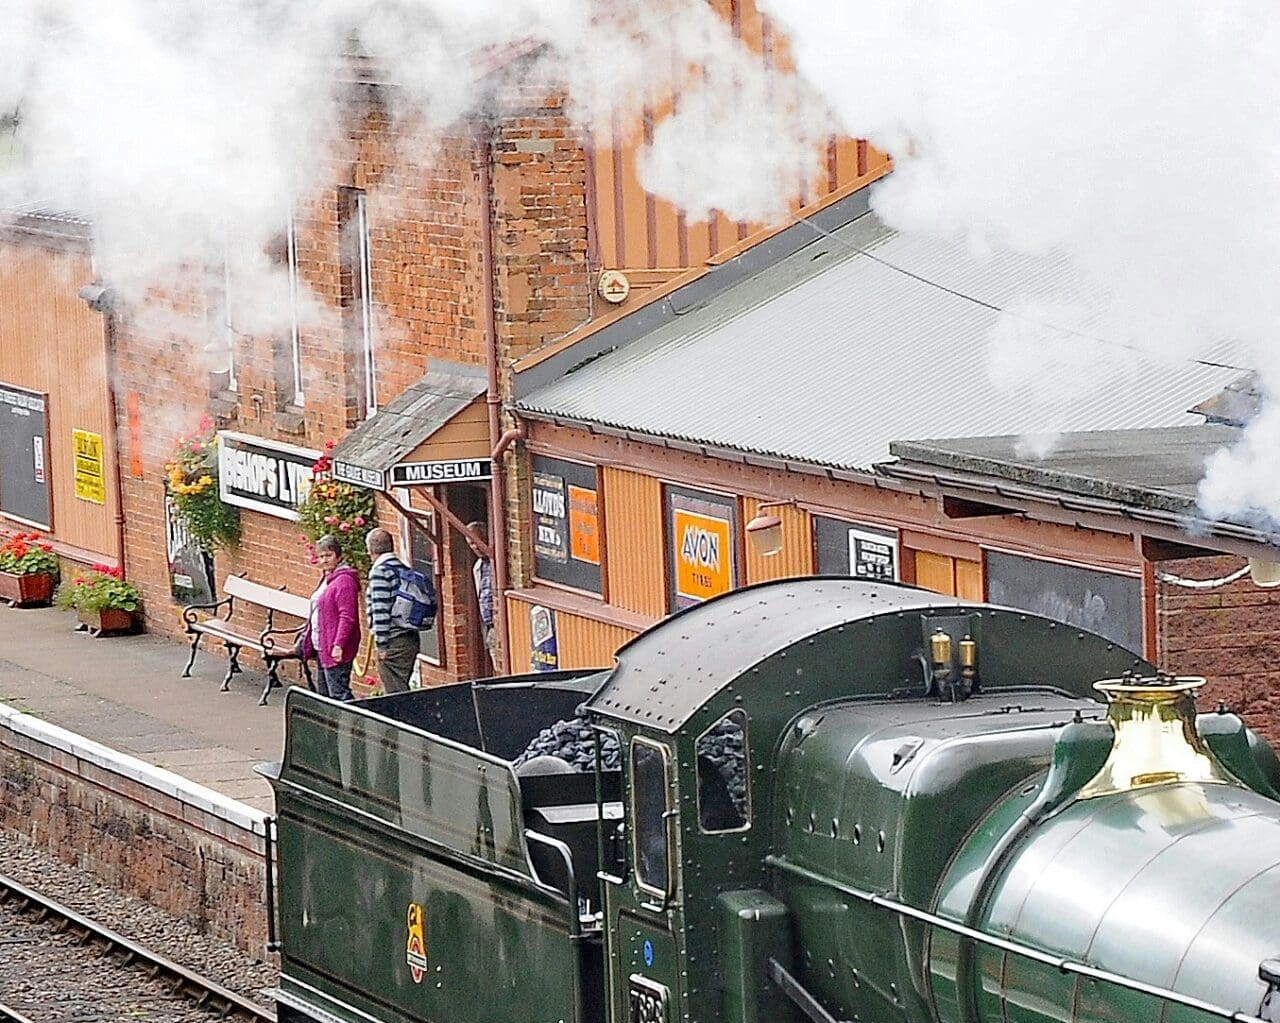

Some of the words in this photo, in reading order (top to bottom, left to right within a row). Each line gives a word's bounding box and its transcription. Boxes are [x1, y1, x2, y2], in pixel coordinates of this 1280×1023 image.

[222, 446, 278, 499] BISHOPS
[406, 462, 481, 481] MUSEUM
[681, 524, 721, 574] AVON
[691, 572, 713, 589] TYRES
